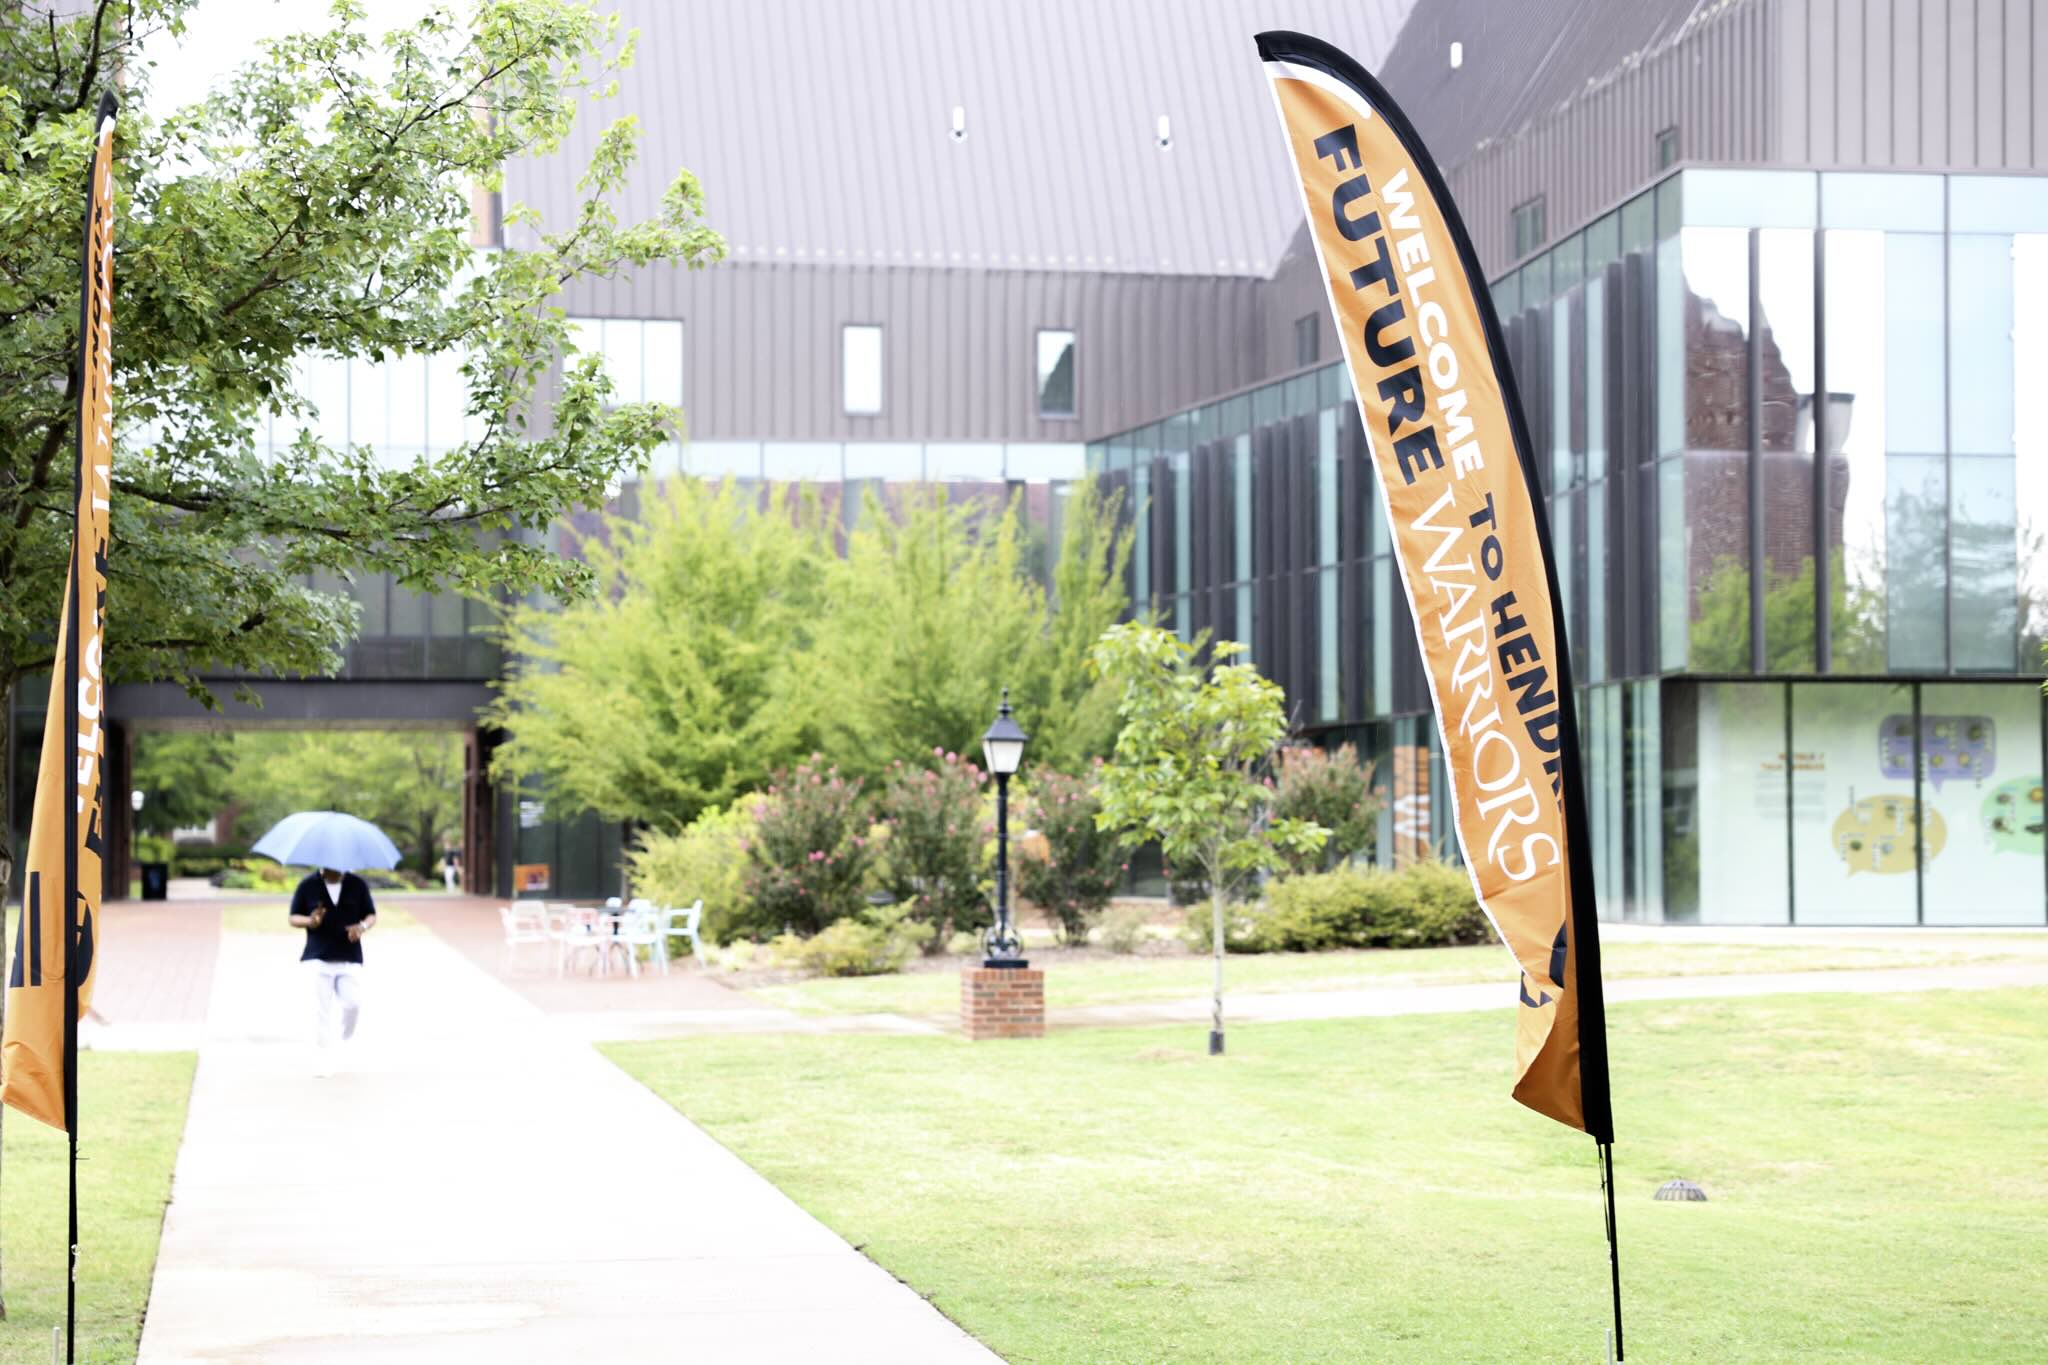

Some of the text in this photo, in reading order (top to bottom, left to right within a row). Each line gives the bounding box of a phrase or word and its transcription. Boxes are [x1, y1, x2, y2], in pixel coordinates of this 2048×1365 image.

[1313, 123, 1561, 881] FUTURE WARRIORS
[1381, 168, 1563, 814] WELCOME TO HEND
